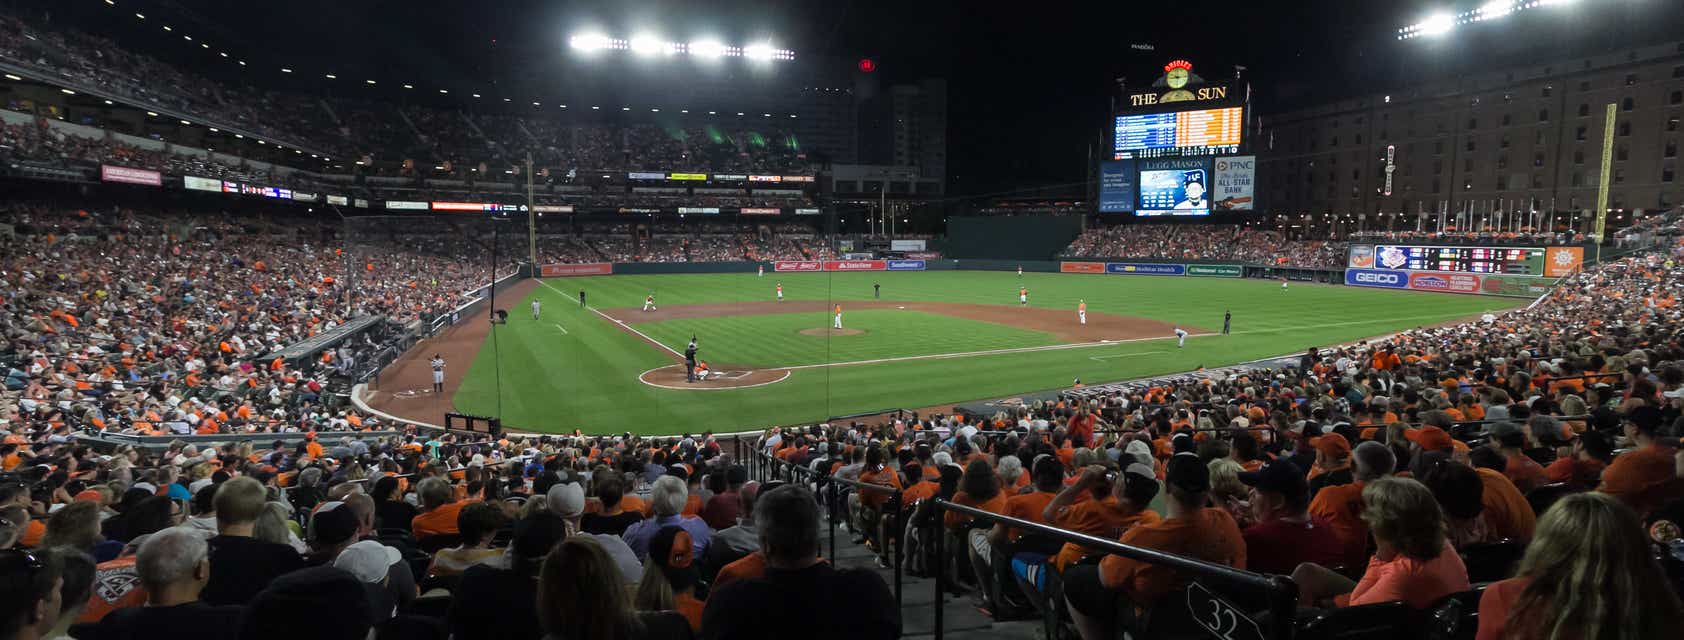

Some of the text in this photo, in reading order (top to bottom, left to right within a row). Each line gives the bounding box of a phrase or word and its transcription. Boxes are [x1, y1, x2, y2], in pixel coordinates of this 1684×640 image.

[1165, 60, 1192, 72] ORIOLES
[1130, 87, 1226, 106] THE SUN
[1171, 160, 1203, 169] MASON
[1230, 161, 1253, 170] PNC
[1355, 272, 1399, 284] GEICO
[1208, 599, 1234, 640] 32
